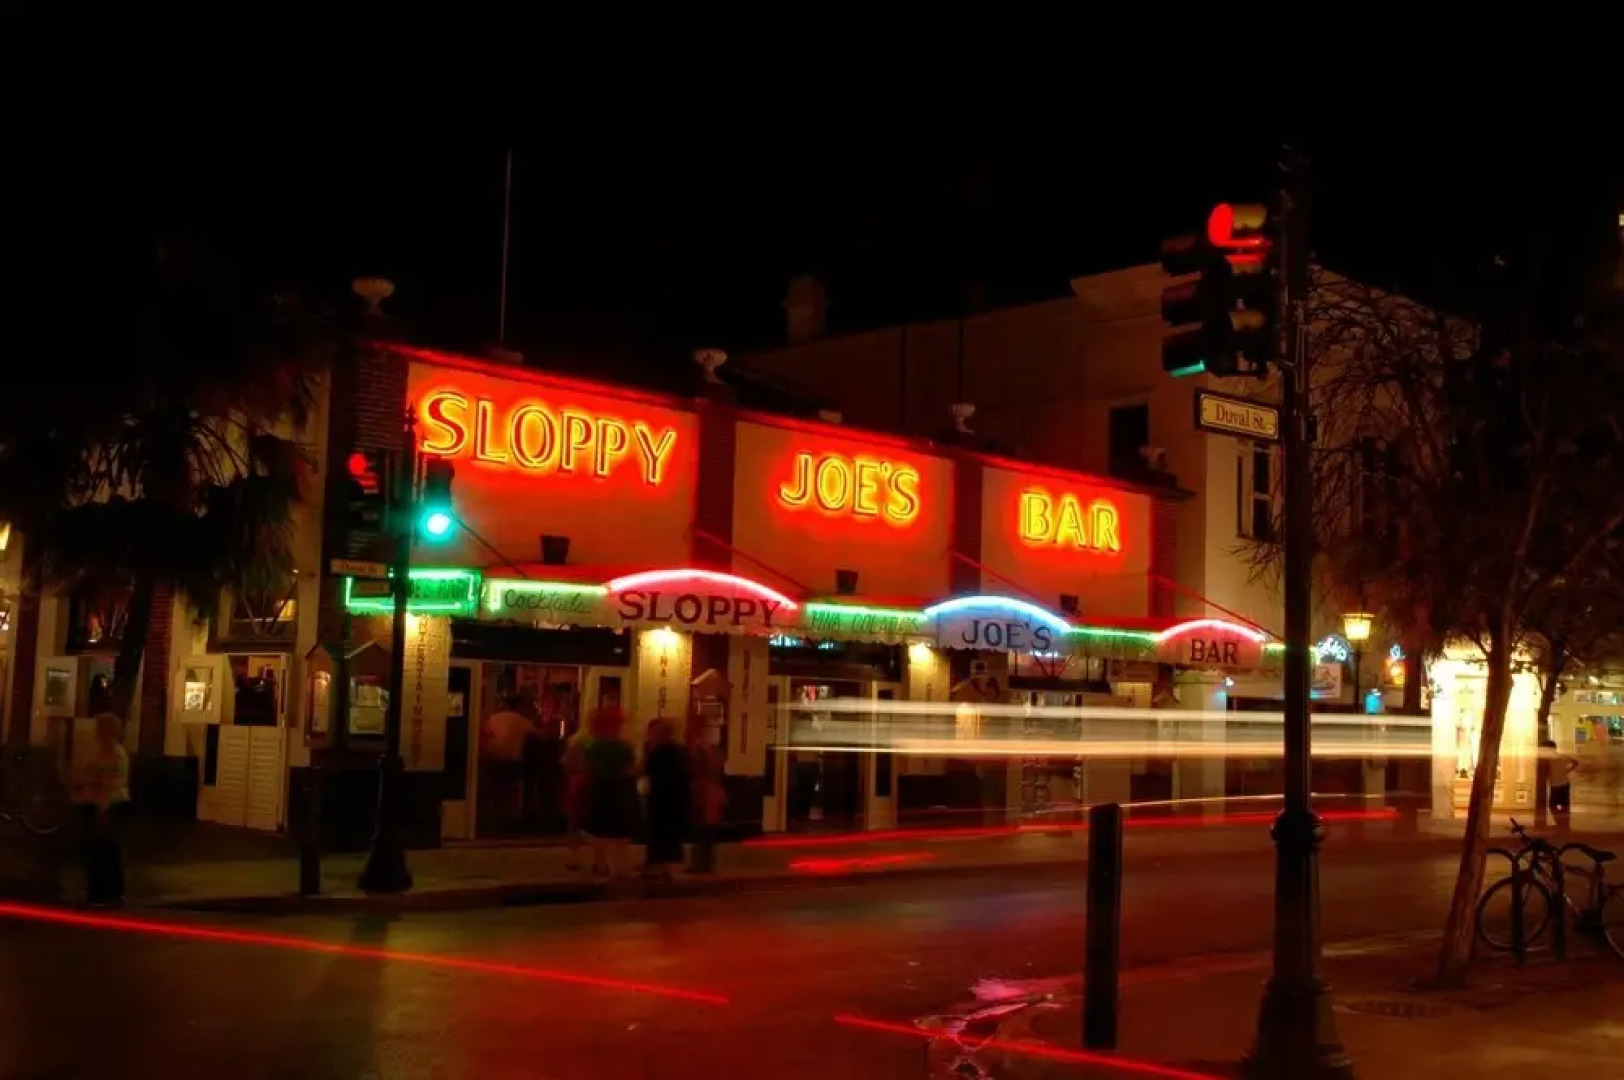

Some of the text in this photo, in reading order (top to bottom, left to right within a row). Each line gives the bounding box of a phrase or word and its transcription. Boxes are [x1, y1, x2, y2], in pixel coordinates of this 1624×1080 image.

[1214, 402, 1250, 428] Duval
[420, 390, 1121, 553] SLOPPY JOE'S BAR
[617, 590, 780, 628] SLOPPY
[962, 620, 1052, 650] JOE'S
[1190, 639, 1239, 665] BAR
